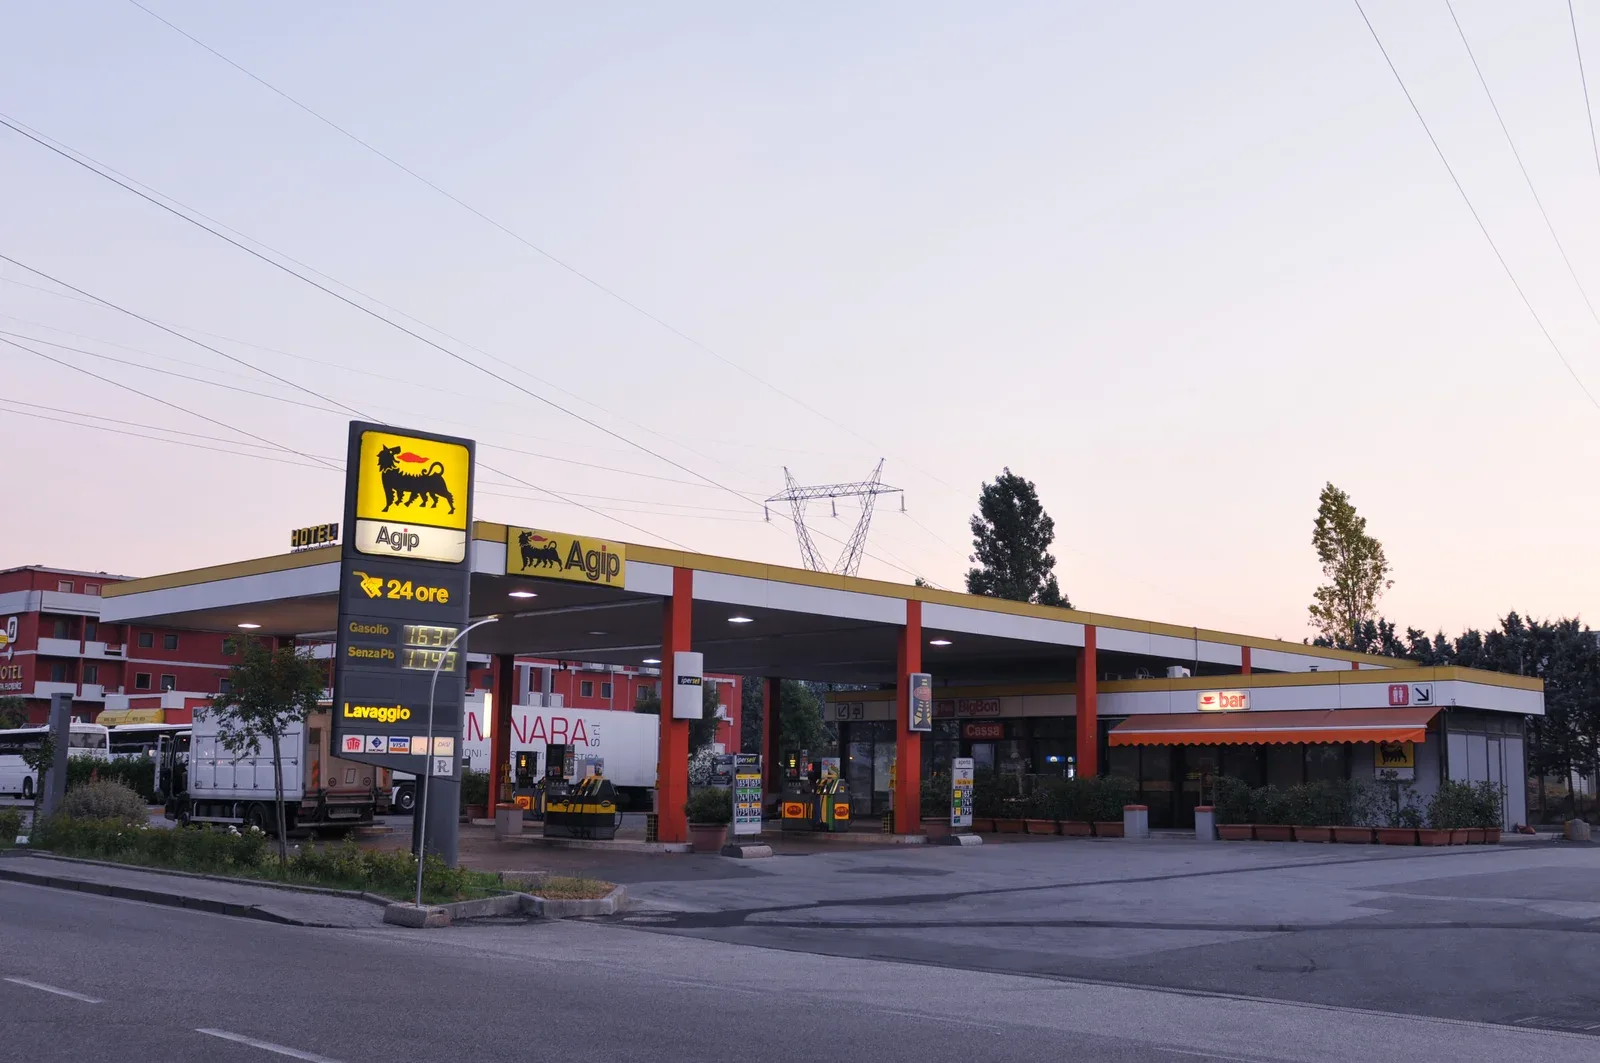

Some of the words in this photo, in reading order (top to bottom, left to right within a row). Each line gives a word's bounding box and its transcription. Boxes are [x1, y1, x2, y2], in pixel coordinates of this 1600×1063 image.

[291, 524, 335, 547] HOTEL
[375, 526, 420, 552] Agip
[564, 540, 620, 583] Agip
[387, 579, 413, 600] 24
[415, 586, 449, 604] ore
[349, 622, 389, 636] Gasolio
[0, 665, 22, 680] OTEL
[958, 700, 998, 715] BigBon
[1219, 691, 1246, 708] bar
[344, 702, 411, 723] Lavaggio
[966, 724, 1000, 737] Cassa
